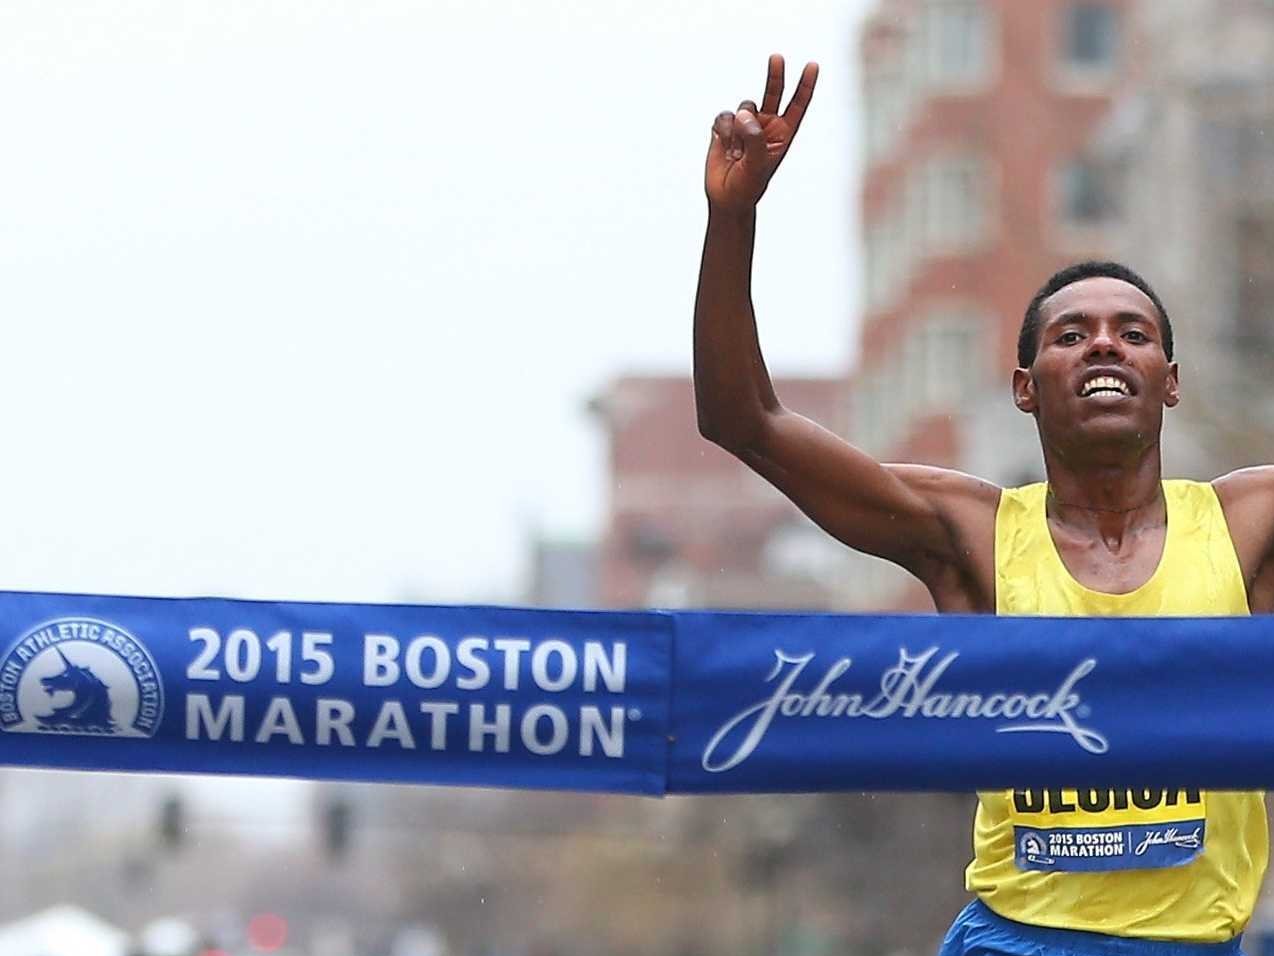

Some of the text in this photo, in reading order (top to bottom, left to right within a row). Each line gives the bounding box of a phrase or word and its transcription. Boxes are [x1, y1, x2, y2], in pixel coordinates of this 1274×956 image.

[16, 622, 101, 661] ATHLETIC
[101, 629, 158, 730] ASSOCIATION
[187, 626, 626, 692] 2015 BOSTON
[186, 691, 625, 757] MARATHON
[702, 645, 1108, 772] John Hancock
[1049, 832, 1123, 844] 2015 BOSTON
[1050, 844, 1124, 857] MARATHON
